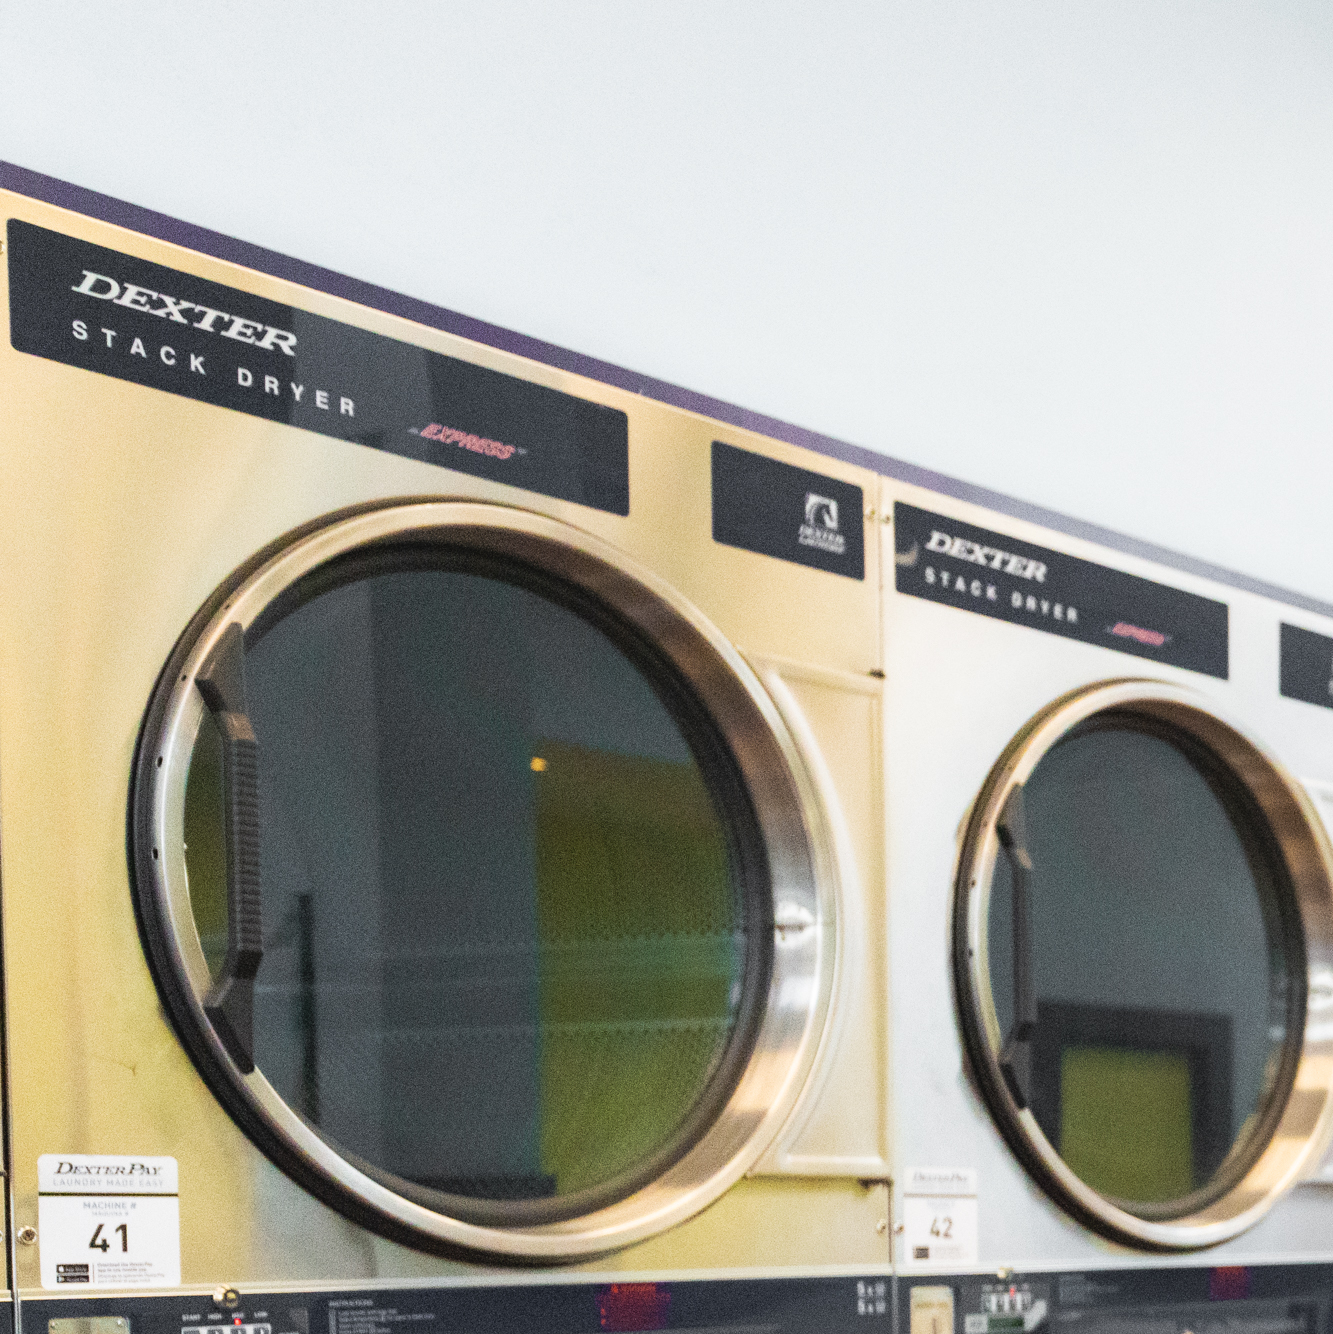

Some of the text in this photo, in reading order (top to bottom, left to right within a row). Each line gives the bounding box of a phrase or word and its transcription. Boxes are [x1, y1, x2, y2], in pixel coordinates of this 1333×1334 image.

[71, 270, 297, 356] DEXTER
[72, 320, 355, 417] STACK DRYER
[420, 423, 516, 460] EXPRESS
[925, 530, 1048, 584] DEXTER
[924, 566, 1079, 625] STACK DRYER
[53, 1178, 102, 1187] LAUNDRY
[106, 1178, 134, 1187] MADE
[83, 1201, 128, 1210] MACHINE
[89, 1223, 129, 1253] 41
[930, 1217, 953, 1239] 42
